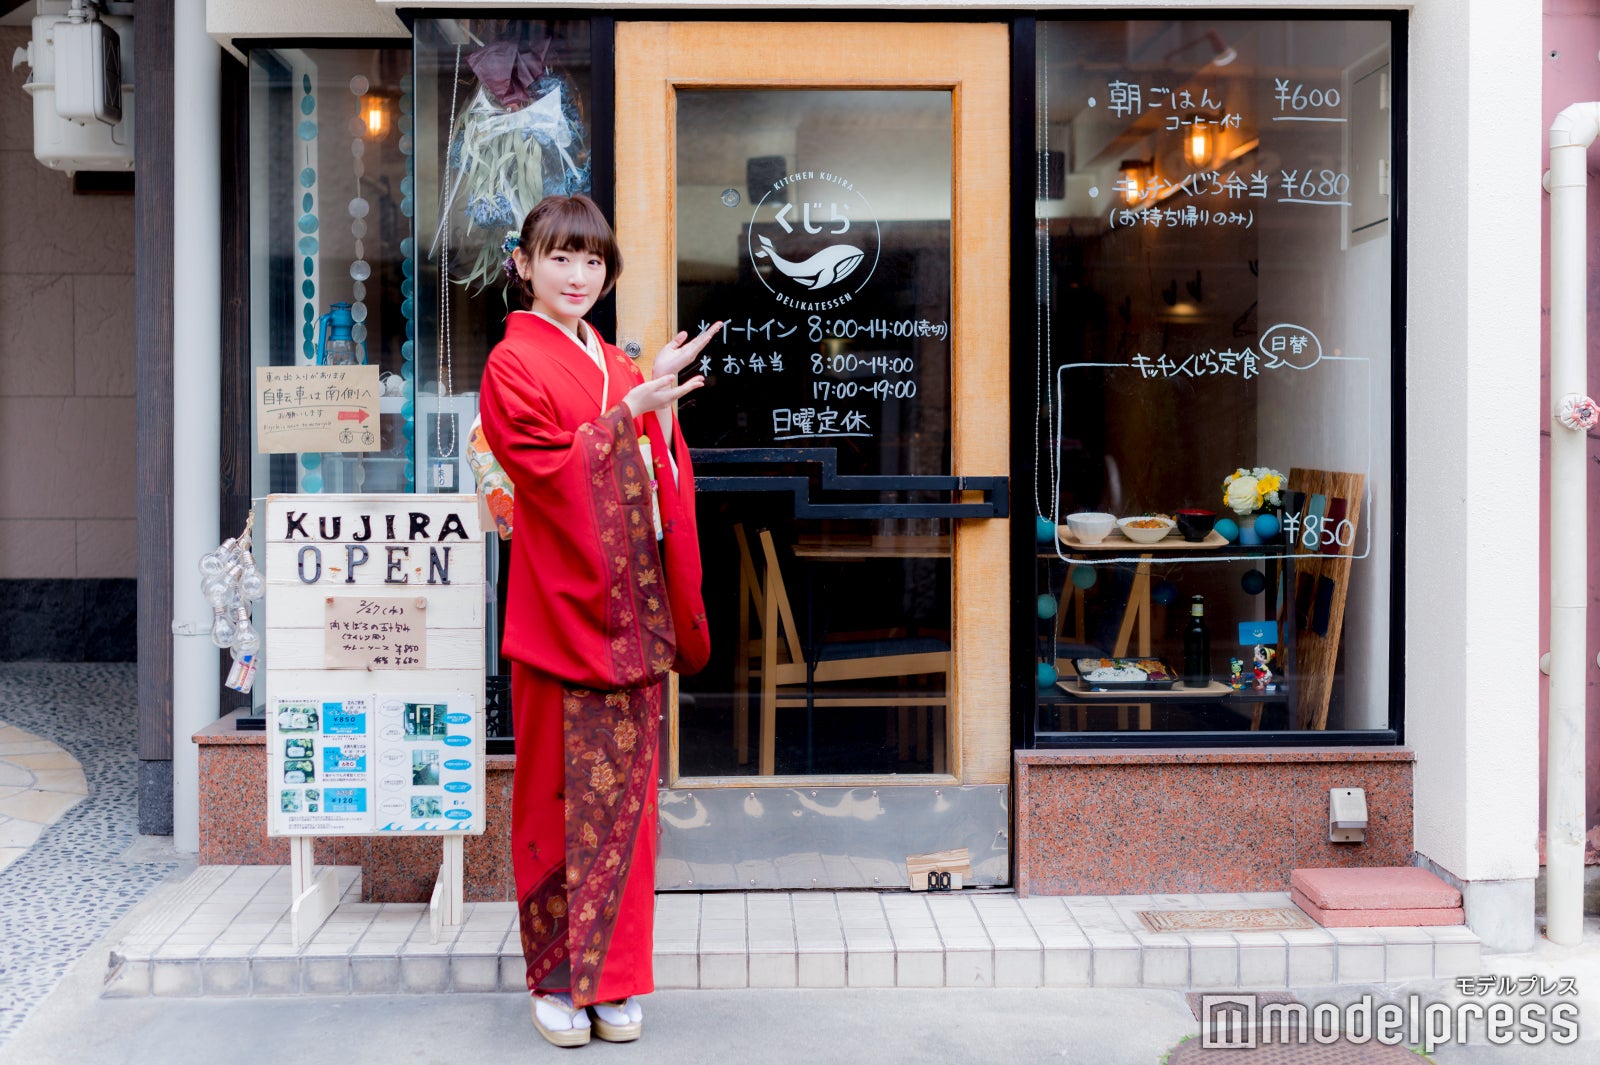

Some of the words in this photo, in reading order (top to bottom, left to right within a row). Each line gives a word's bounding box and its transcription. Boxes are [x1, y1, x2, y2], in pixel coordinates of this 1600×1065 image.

[1107, 80, 1222, 118] 朝ごはん
[1274, 78, 1341, 112] ¥600
[1165, 113, 1243, 131] コーヒー付
[773, 171, 815, 191] KITCHEN
[819, 171, 853, 192] KUJIRA
[1111, 169, 1269, 202] キッチンくじら弁当
[1280, 169, 1350, 198] ¥680
[774, 202, 851, 235] くじら
[1109, 205, 1254, 229] (お持ち帰りのみ)
[775, 292, 853, 311] DELIKATESSEN
[720, 318, 798, 345] イートイン
[1271, 335, 1309, 354] 日替
[721, 351, 785, 375] お弁当
[263, 385, 372, 406] 自転車は南側へ
[772, 405, 871, 434] 日曜定休
[284, 511, 470, 542] KUJIRA
[1283, 511, 1355, 547] ¥850
[297, 544, 452, 585] OPEN
